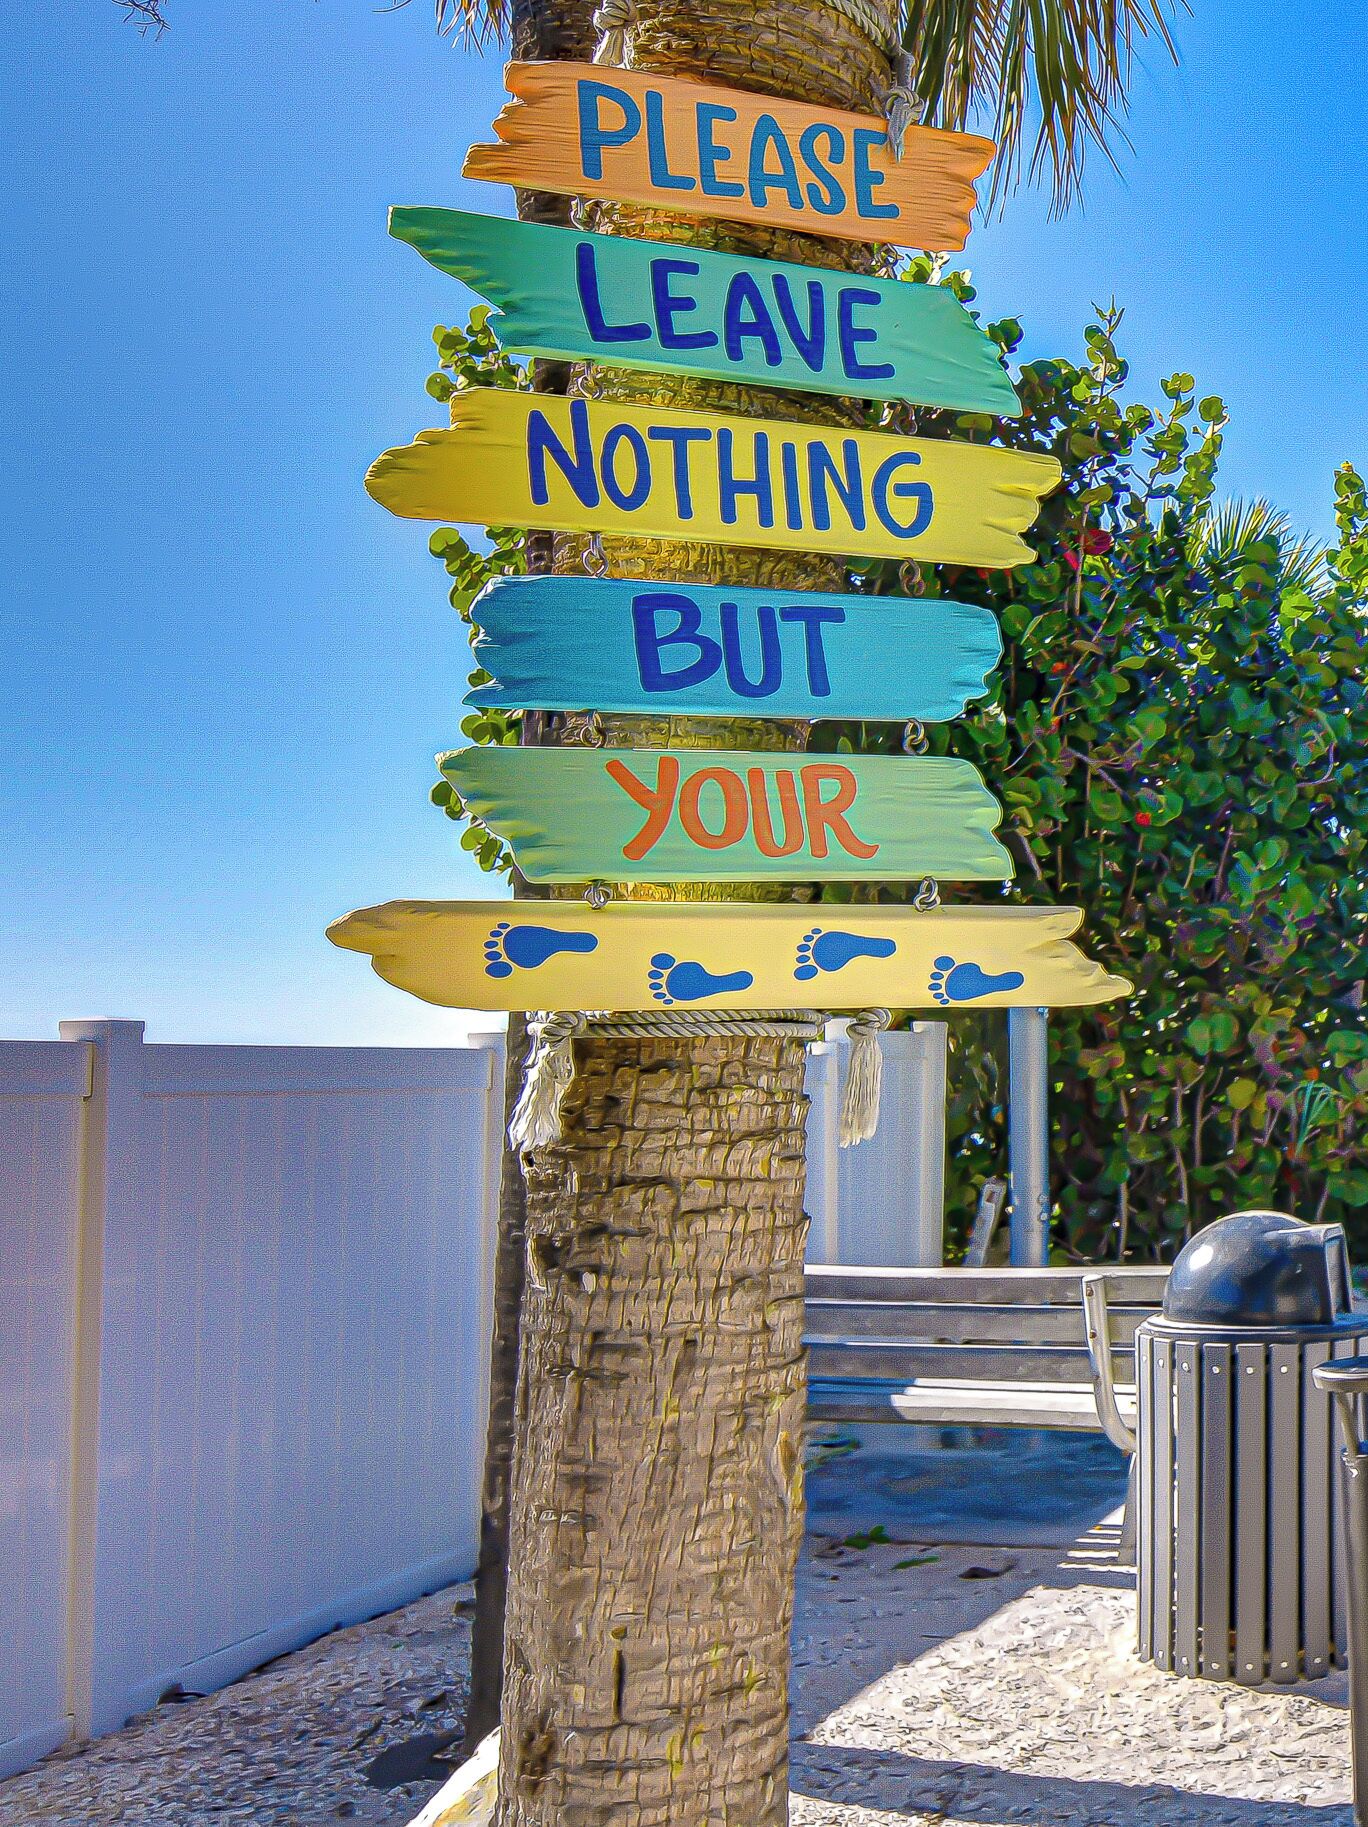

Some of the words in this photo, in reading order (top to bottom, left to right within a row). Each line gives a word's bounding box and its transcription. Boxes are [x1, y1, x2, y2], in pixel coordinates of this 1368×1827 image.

[577, 79, 900, 220] PLEASE
[576, 242, 896, 380] LEAVE
[527, 400, 934, 539] NOTHING
[633, 593, 845, 698] BUT
[606, 757, 879, 860] YOUR
